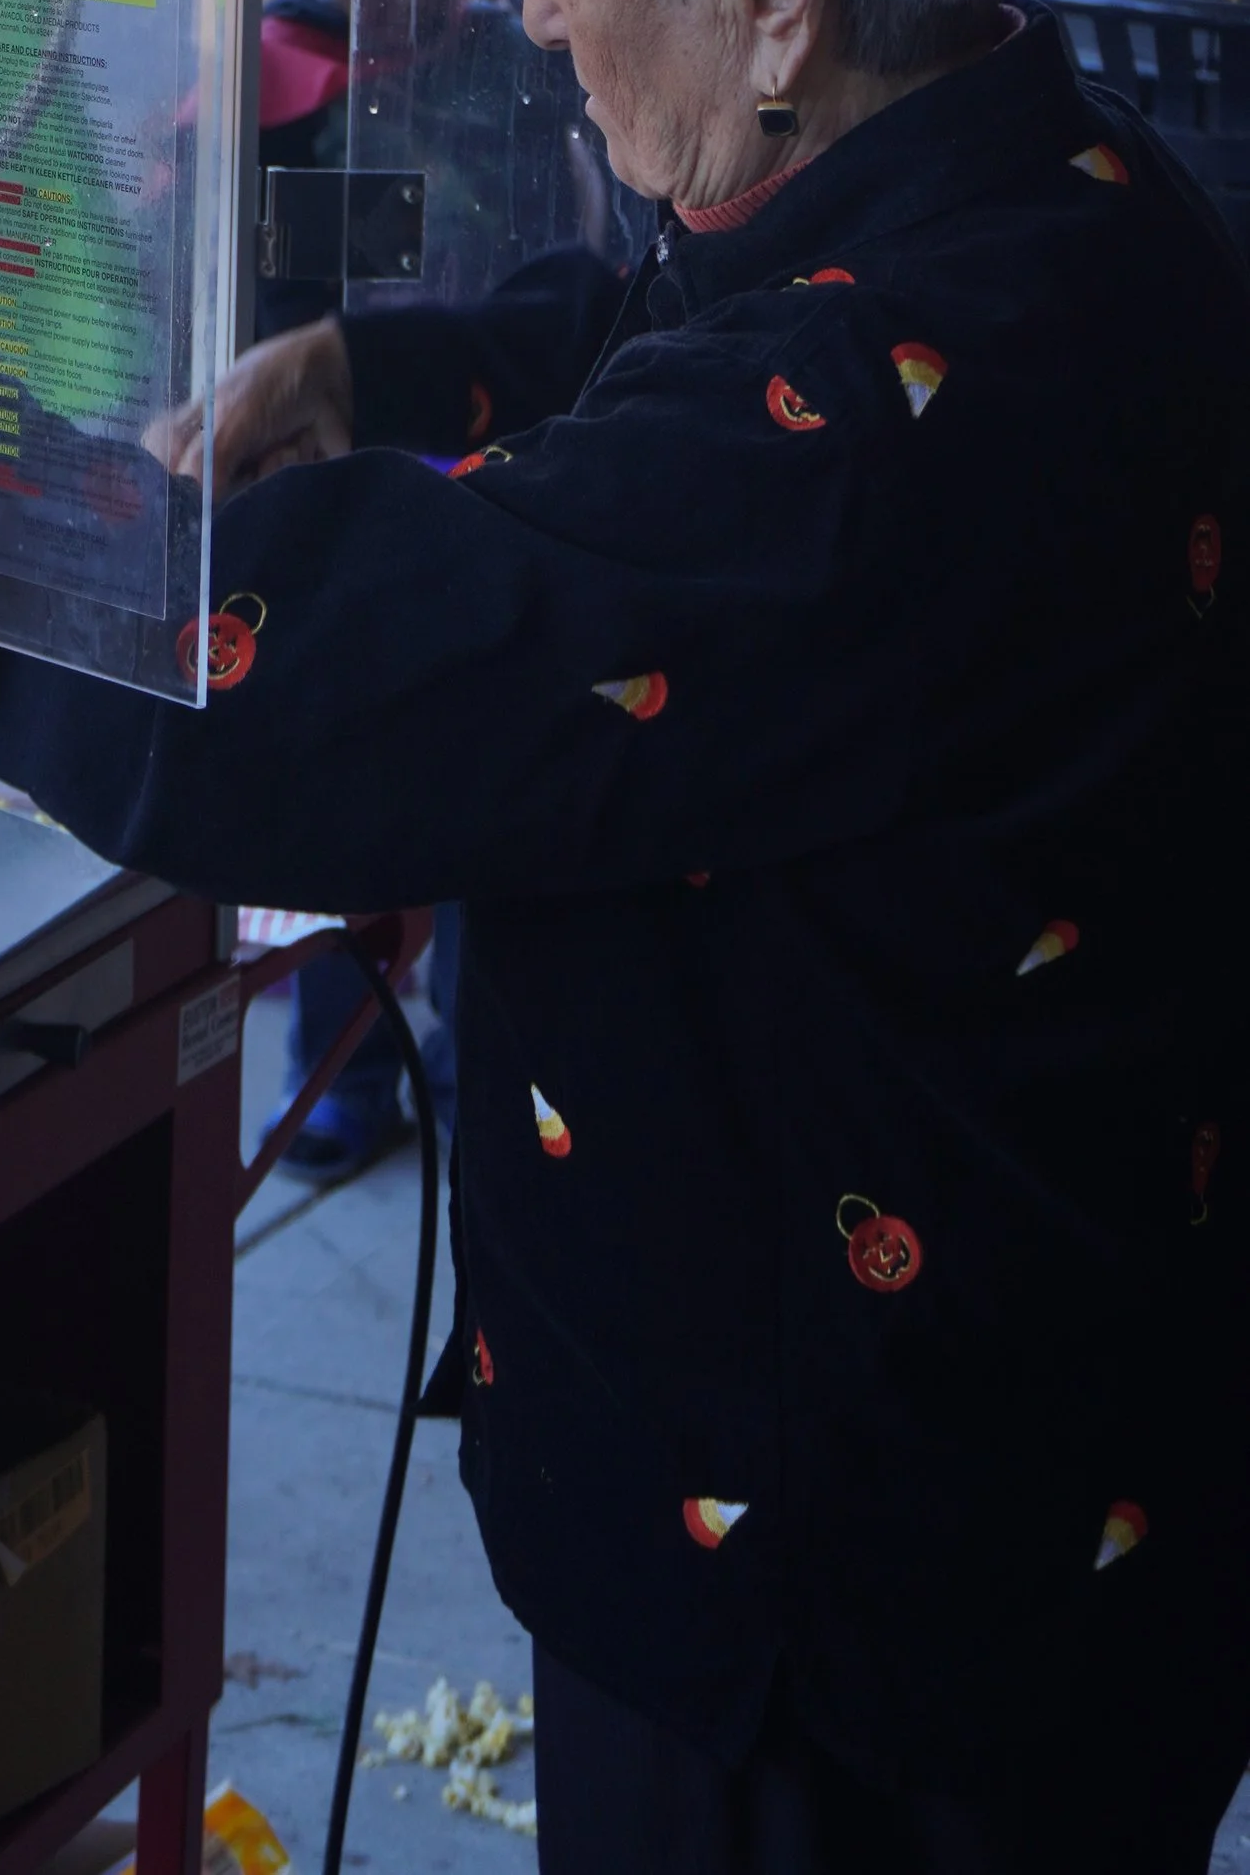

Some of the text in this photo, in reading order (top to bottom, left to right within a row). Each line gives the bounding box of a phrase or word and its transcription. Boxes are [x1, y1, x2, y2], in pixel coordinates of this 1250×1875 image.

[25, 13, 43, 25] GOLD
[44, 16, 65, 28] MEDAL
[66, 19, 100, 34] PRODUCTS
[11, 44, 24, 55] AND
[26, 46, 58, 61] CLEANING
[59, 51, 107, 70] INSTRUCTIONS:
[8, 115, 21, 125] NOT
[68, 149, 104, 165] WATCHDOG
[11, 163, 27, 174] HEAT
[36, 167, 57, 179] KLEEN
[58, 171, 81, 184] KETTLE
[83, 176, 113, 190] CLEANER
[115, 182, 141, 196] WEEKLY
[24, 186, 37, 198] AND
[22, 210, 124, 238] SAFE OPERATING INSTRUCTIONS
[35, 258, 81, 276] INSTRUCTIONS
[82, 268, 100, 280] POUR
[102, 272, 139, 288] OPERATION
